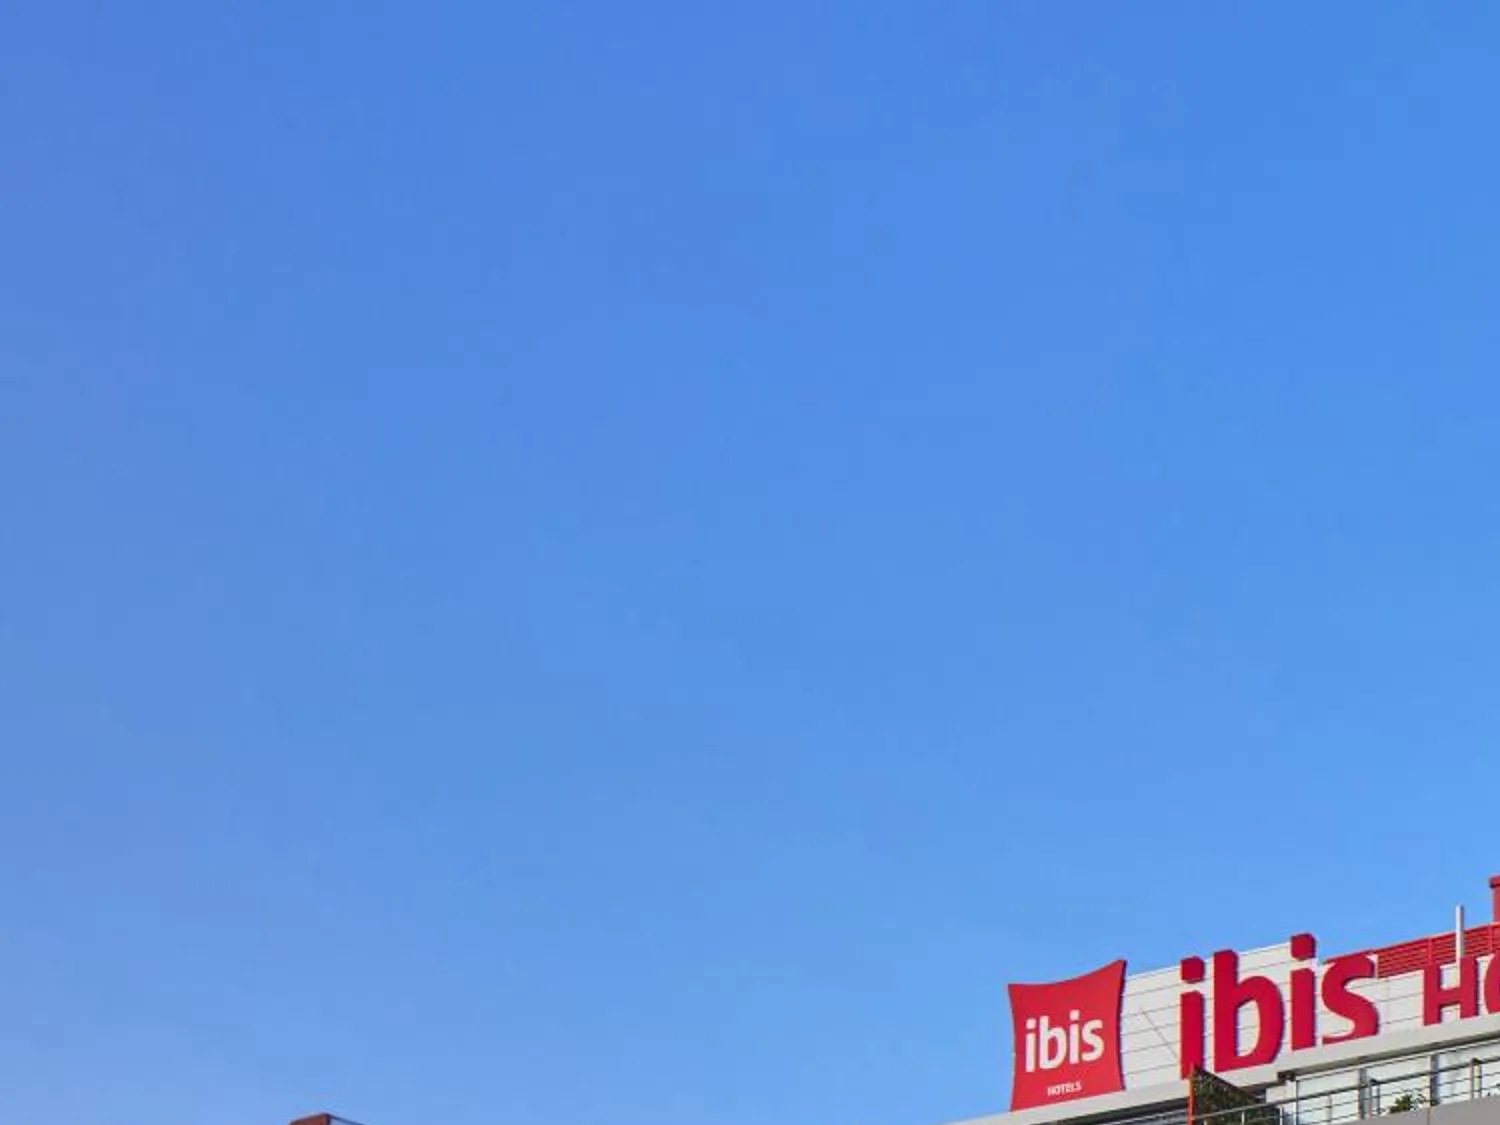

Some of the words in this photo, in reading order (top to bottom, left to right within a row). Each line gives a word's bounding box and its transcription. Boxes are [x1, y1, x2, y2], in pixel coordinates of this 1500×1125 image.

[1180, 932, 1380, 1081] ibis
[1025, 1009, 1105, 1073] ibis
[1047, 1080, 1082, 1096] HOTELS
